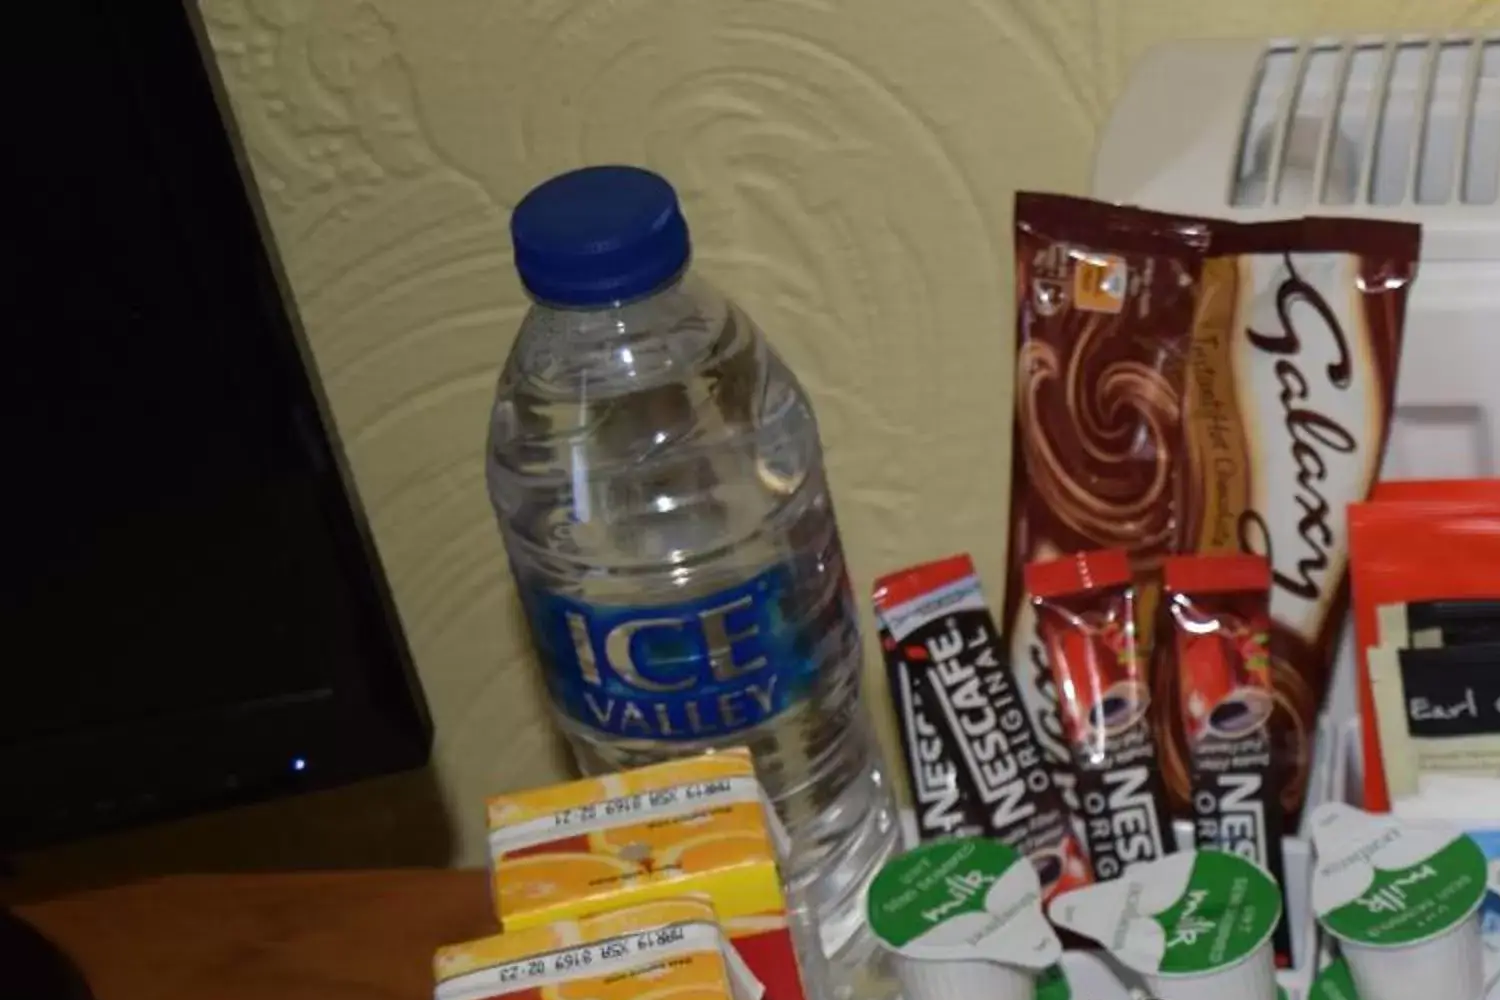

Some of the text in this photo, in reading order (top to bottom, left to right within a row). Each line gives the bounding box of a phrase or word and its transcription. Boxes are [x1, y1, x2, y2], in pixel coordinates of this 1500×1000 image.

[1241, 250, 1357, 600] Galaxy
[563, 596, 768, 691] ICE
[583, 674, 777, 736] VALLEY
[968, 626, 1050, 791] ORIGINAL
[1410, 690, 1478, 721] Earl
[1085, 793, 1120, 878] ORIG
[1104, 766, 1164, 863] NES
[923, 869, 997, 922] milk
[1356, 864, 1437, 914] milk
